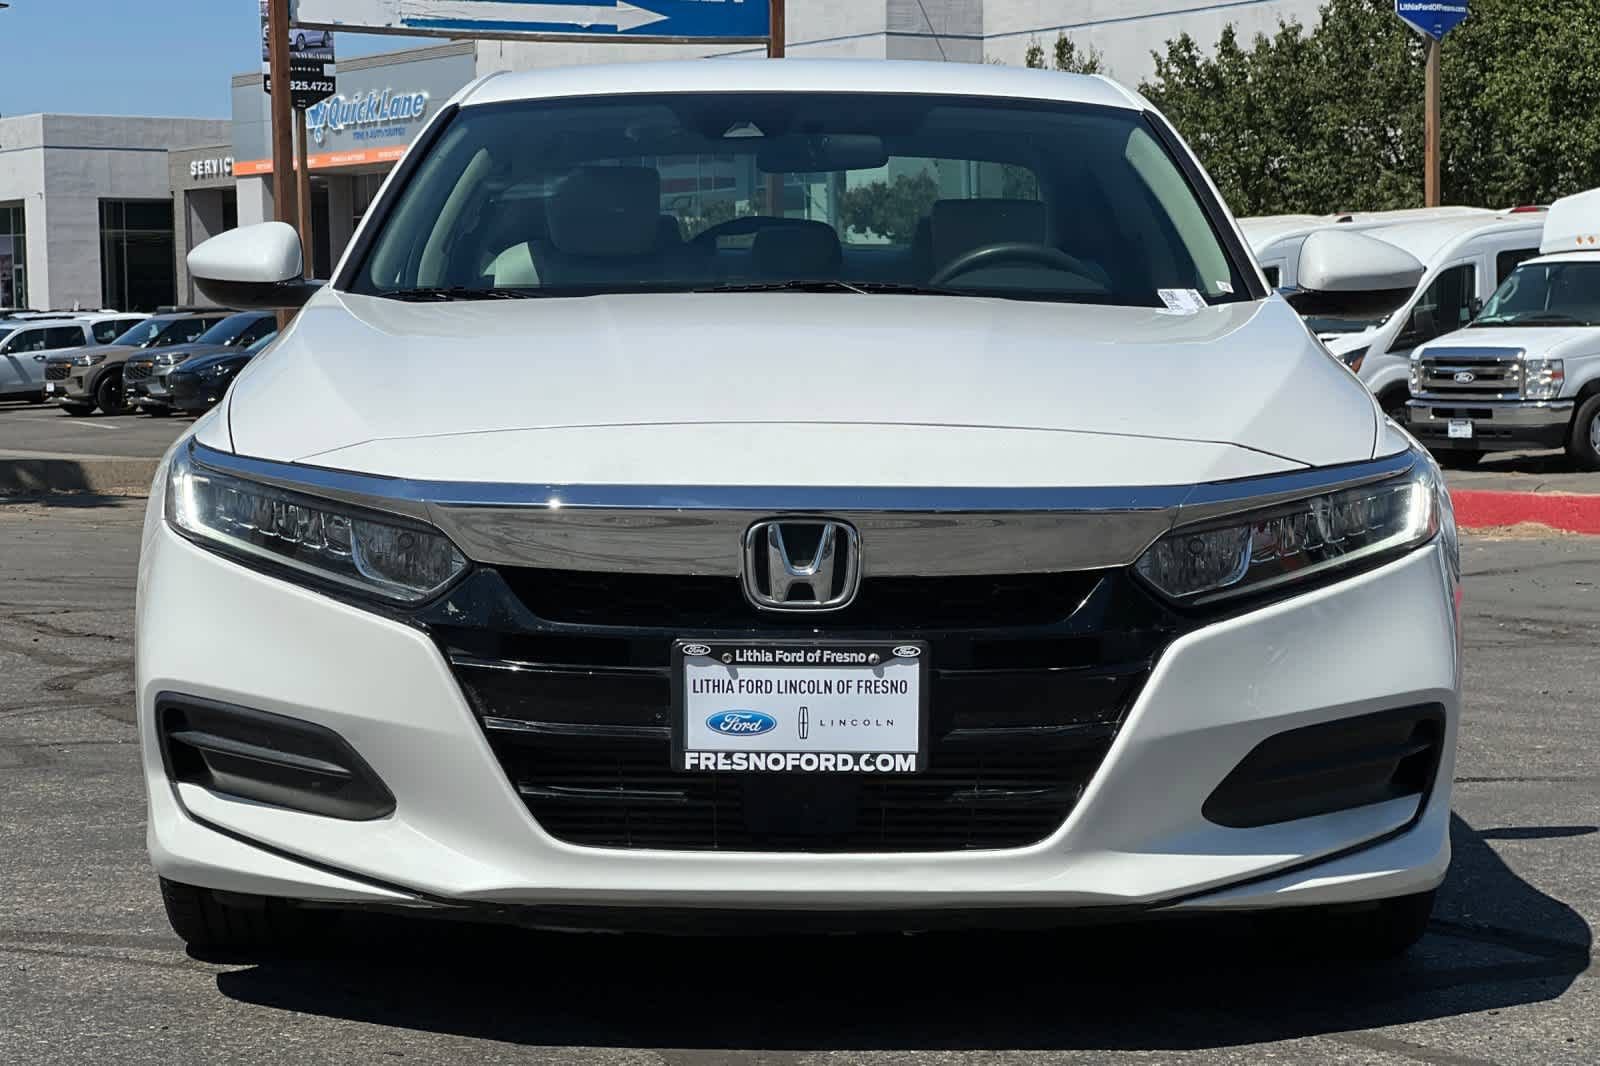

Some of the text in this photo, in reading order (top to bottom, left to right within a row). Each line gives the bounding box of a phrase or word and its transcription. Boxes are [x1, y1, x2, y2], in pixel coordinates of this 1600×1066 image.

[328, 90, 426, 129] Quick Lane
[190, 157, 234, 176] SERVIC
[735, 650, 867, 663] Lithia Ford of Fresno
[692, 679, 908, 695] LITHIA FORD LINCOLN OF FRESNO
[718, 712, 764, 734] Ford
[819, 719, 895, 727] LINCOLN
[685, 752, 916, 772] FRESNOFORD.COM
